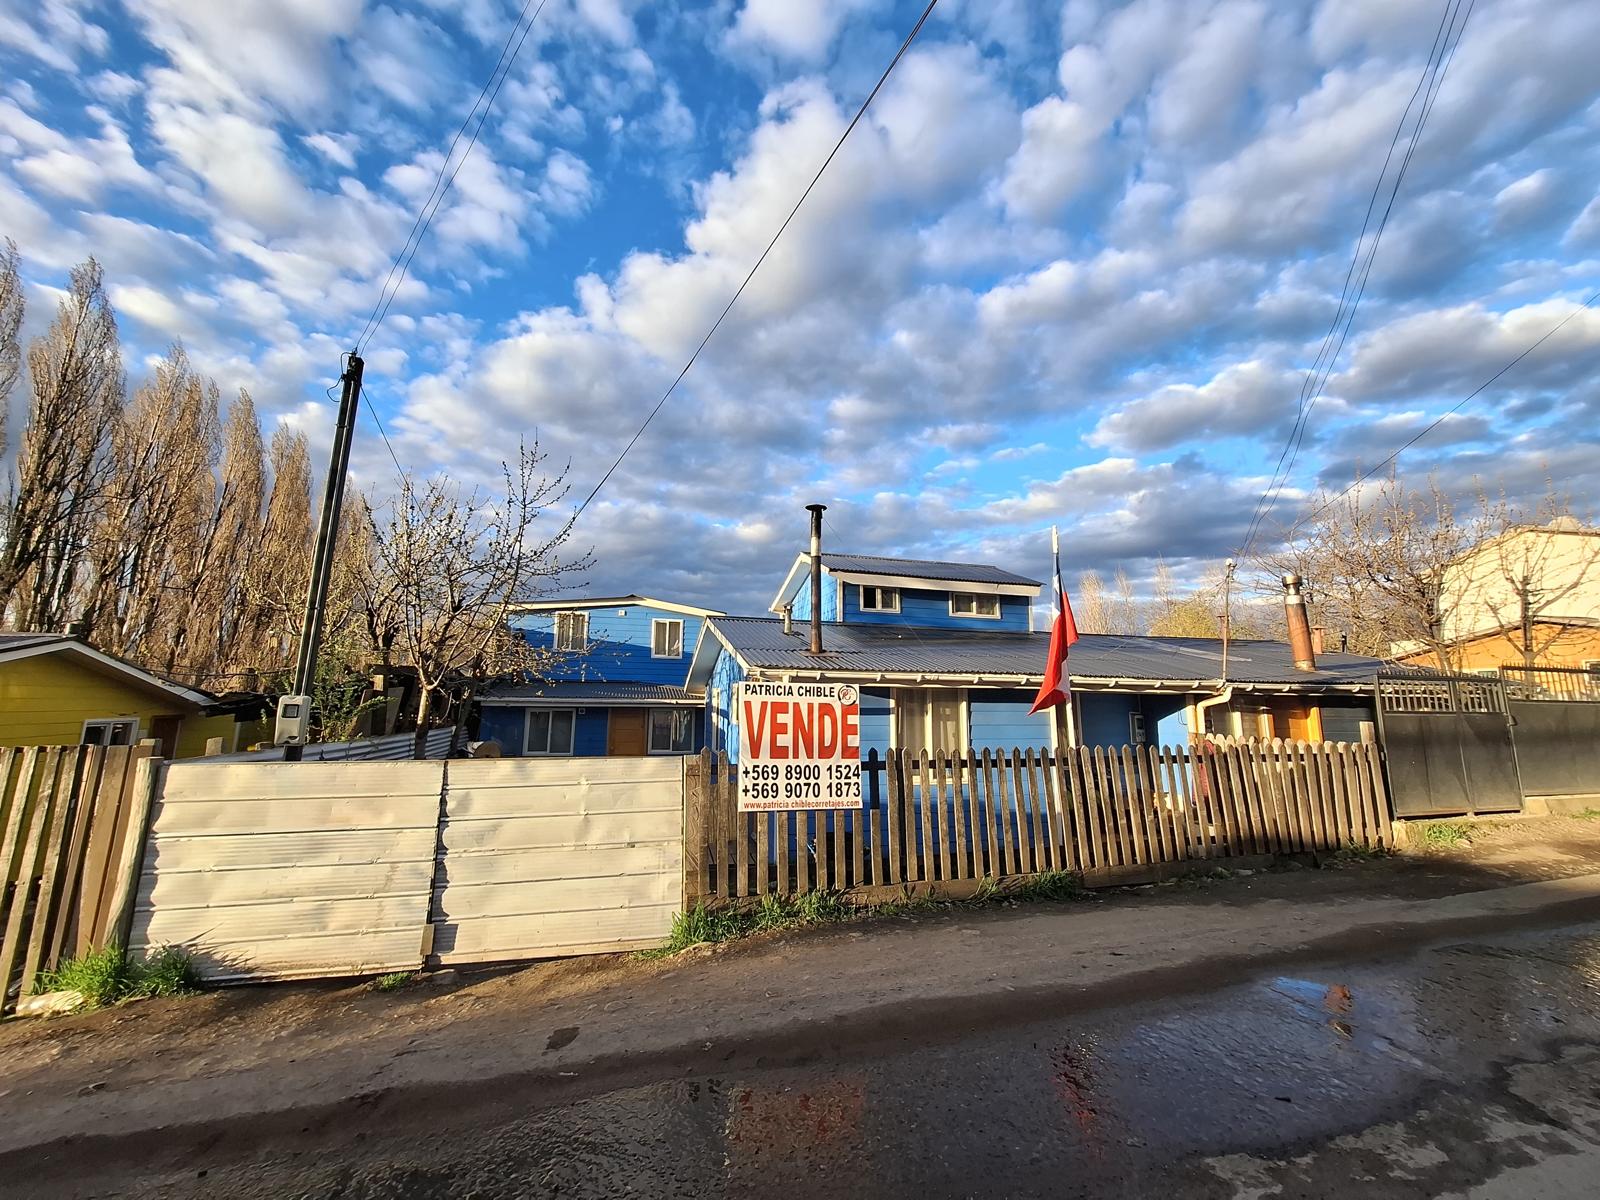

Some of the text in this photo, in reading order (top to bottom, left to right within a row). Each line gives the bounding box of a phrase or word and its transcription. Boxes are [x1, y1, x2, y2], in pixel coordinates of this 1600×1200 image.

[744, 684, 794, 697] PATRICIA
[797, 685, 835, 698] CHIBLE
[744, 701, 860, 760] VENDE
[742, 764, 860, 780] +569 8900 1524
[742, 782, 860, 799] +569 9070 1873
[744, 800, 789, 810] www.patricia
